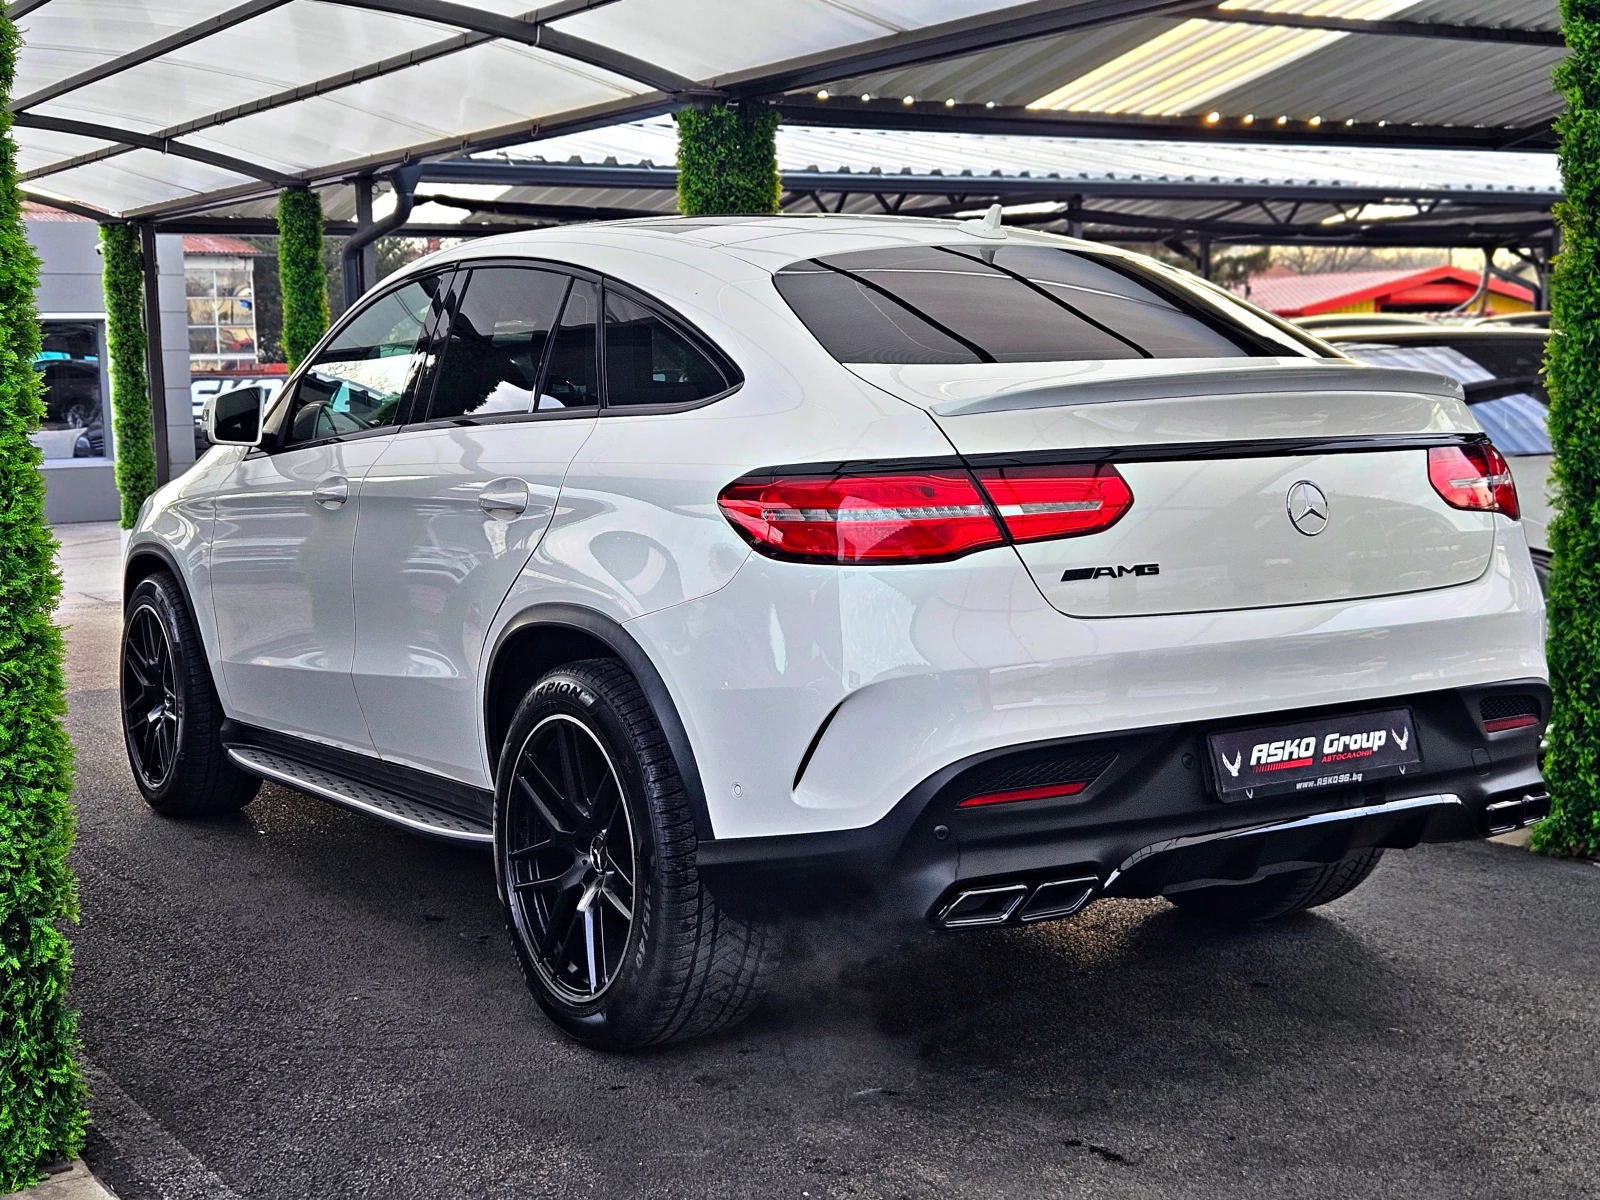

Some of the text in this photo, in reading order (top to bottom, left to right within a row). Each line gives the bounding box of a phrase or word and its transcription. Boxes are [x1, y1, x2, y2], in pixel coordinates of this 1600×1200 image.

[1250, 730, 1386, 766] ASKO Group
[1322, 749, 1373, 763] АВТОСАЛОНИ
